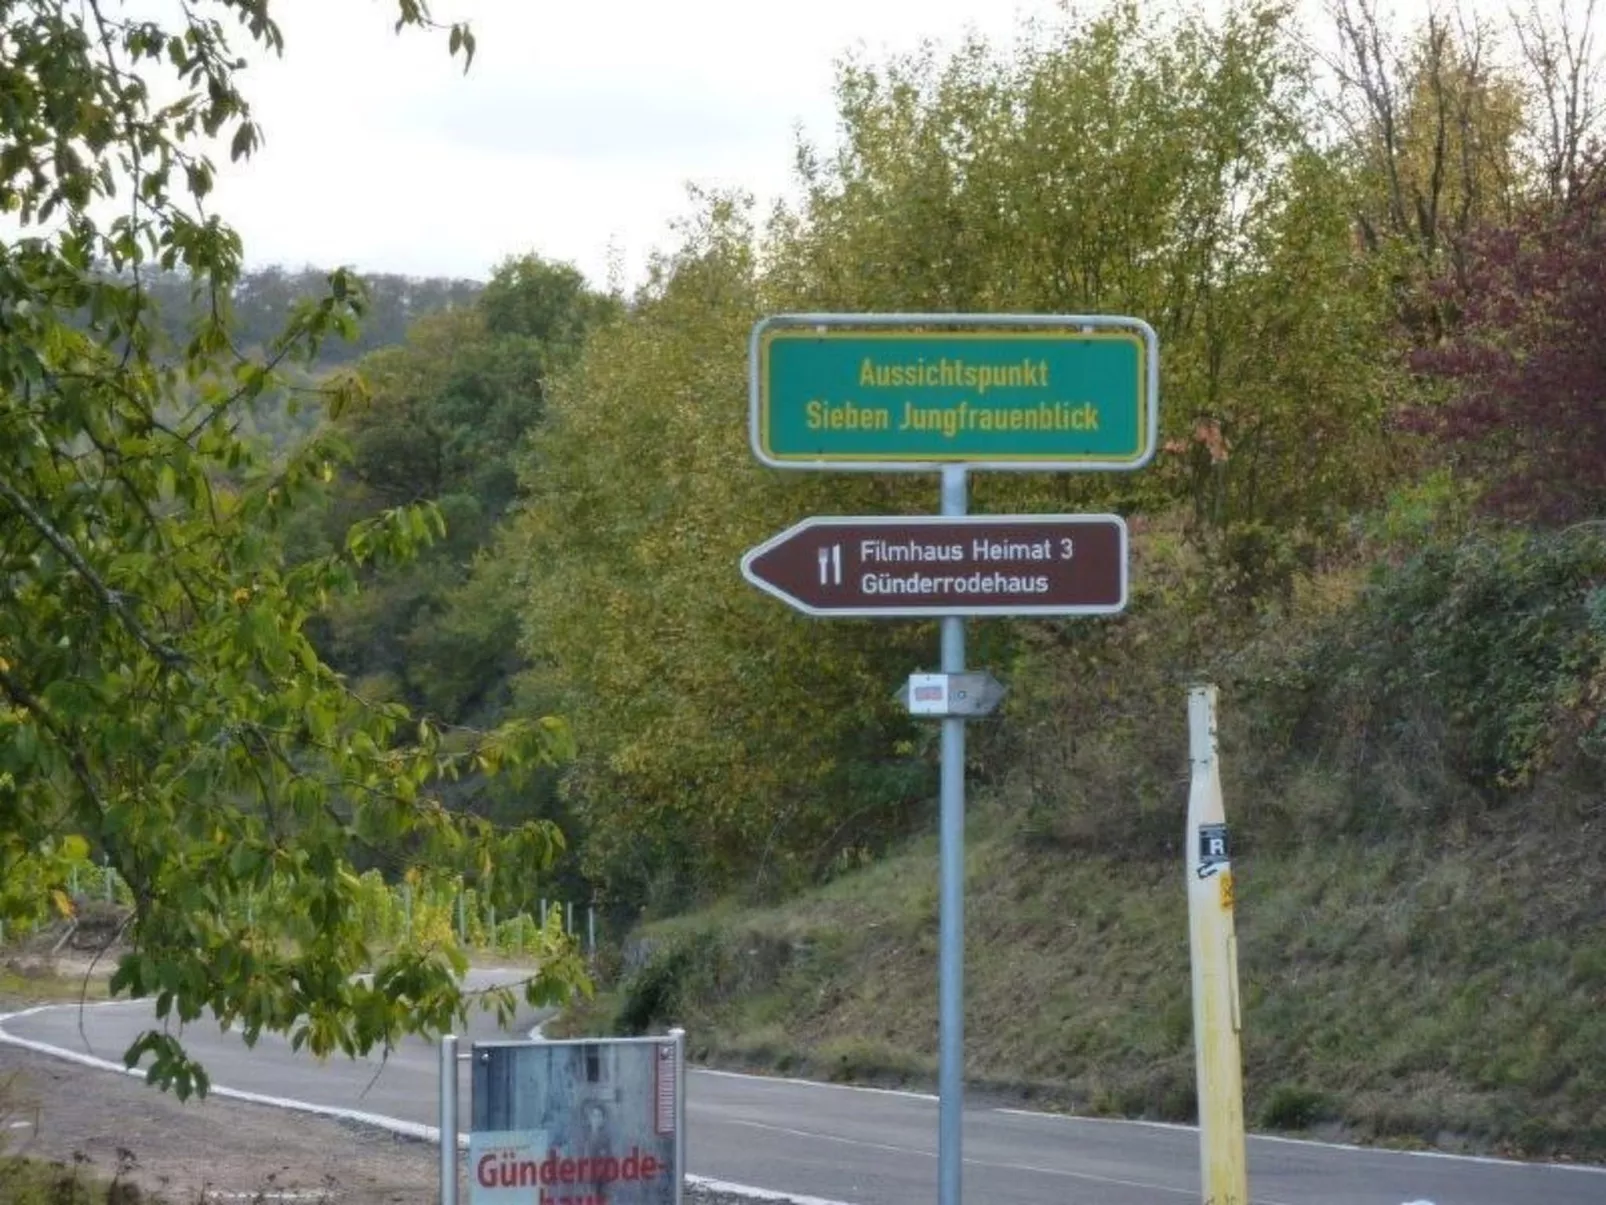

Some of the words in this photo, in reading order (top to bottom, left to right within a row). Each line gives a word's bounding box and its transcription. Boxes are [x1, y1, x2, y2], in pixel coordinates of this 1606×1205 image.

[859, 357, 1049, 393] Aussichtspunkt
[806, 402, 889, 431] Sieben
[899, 402, 1099, 438] Jungfrauenblick
[860, 539, 964, 562] Filmhaus
[972, 539, 1052, 560] Heimat
[1060, 538, 1075, 559] 3
[861, 573, 1049, 594] Günderrodehaus
[477, 1146, 665, 1188] Günderrode-
